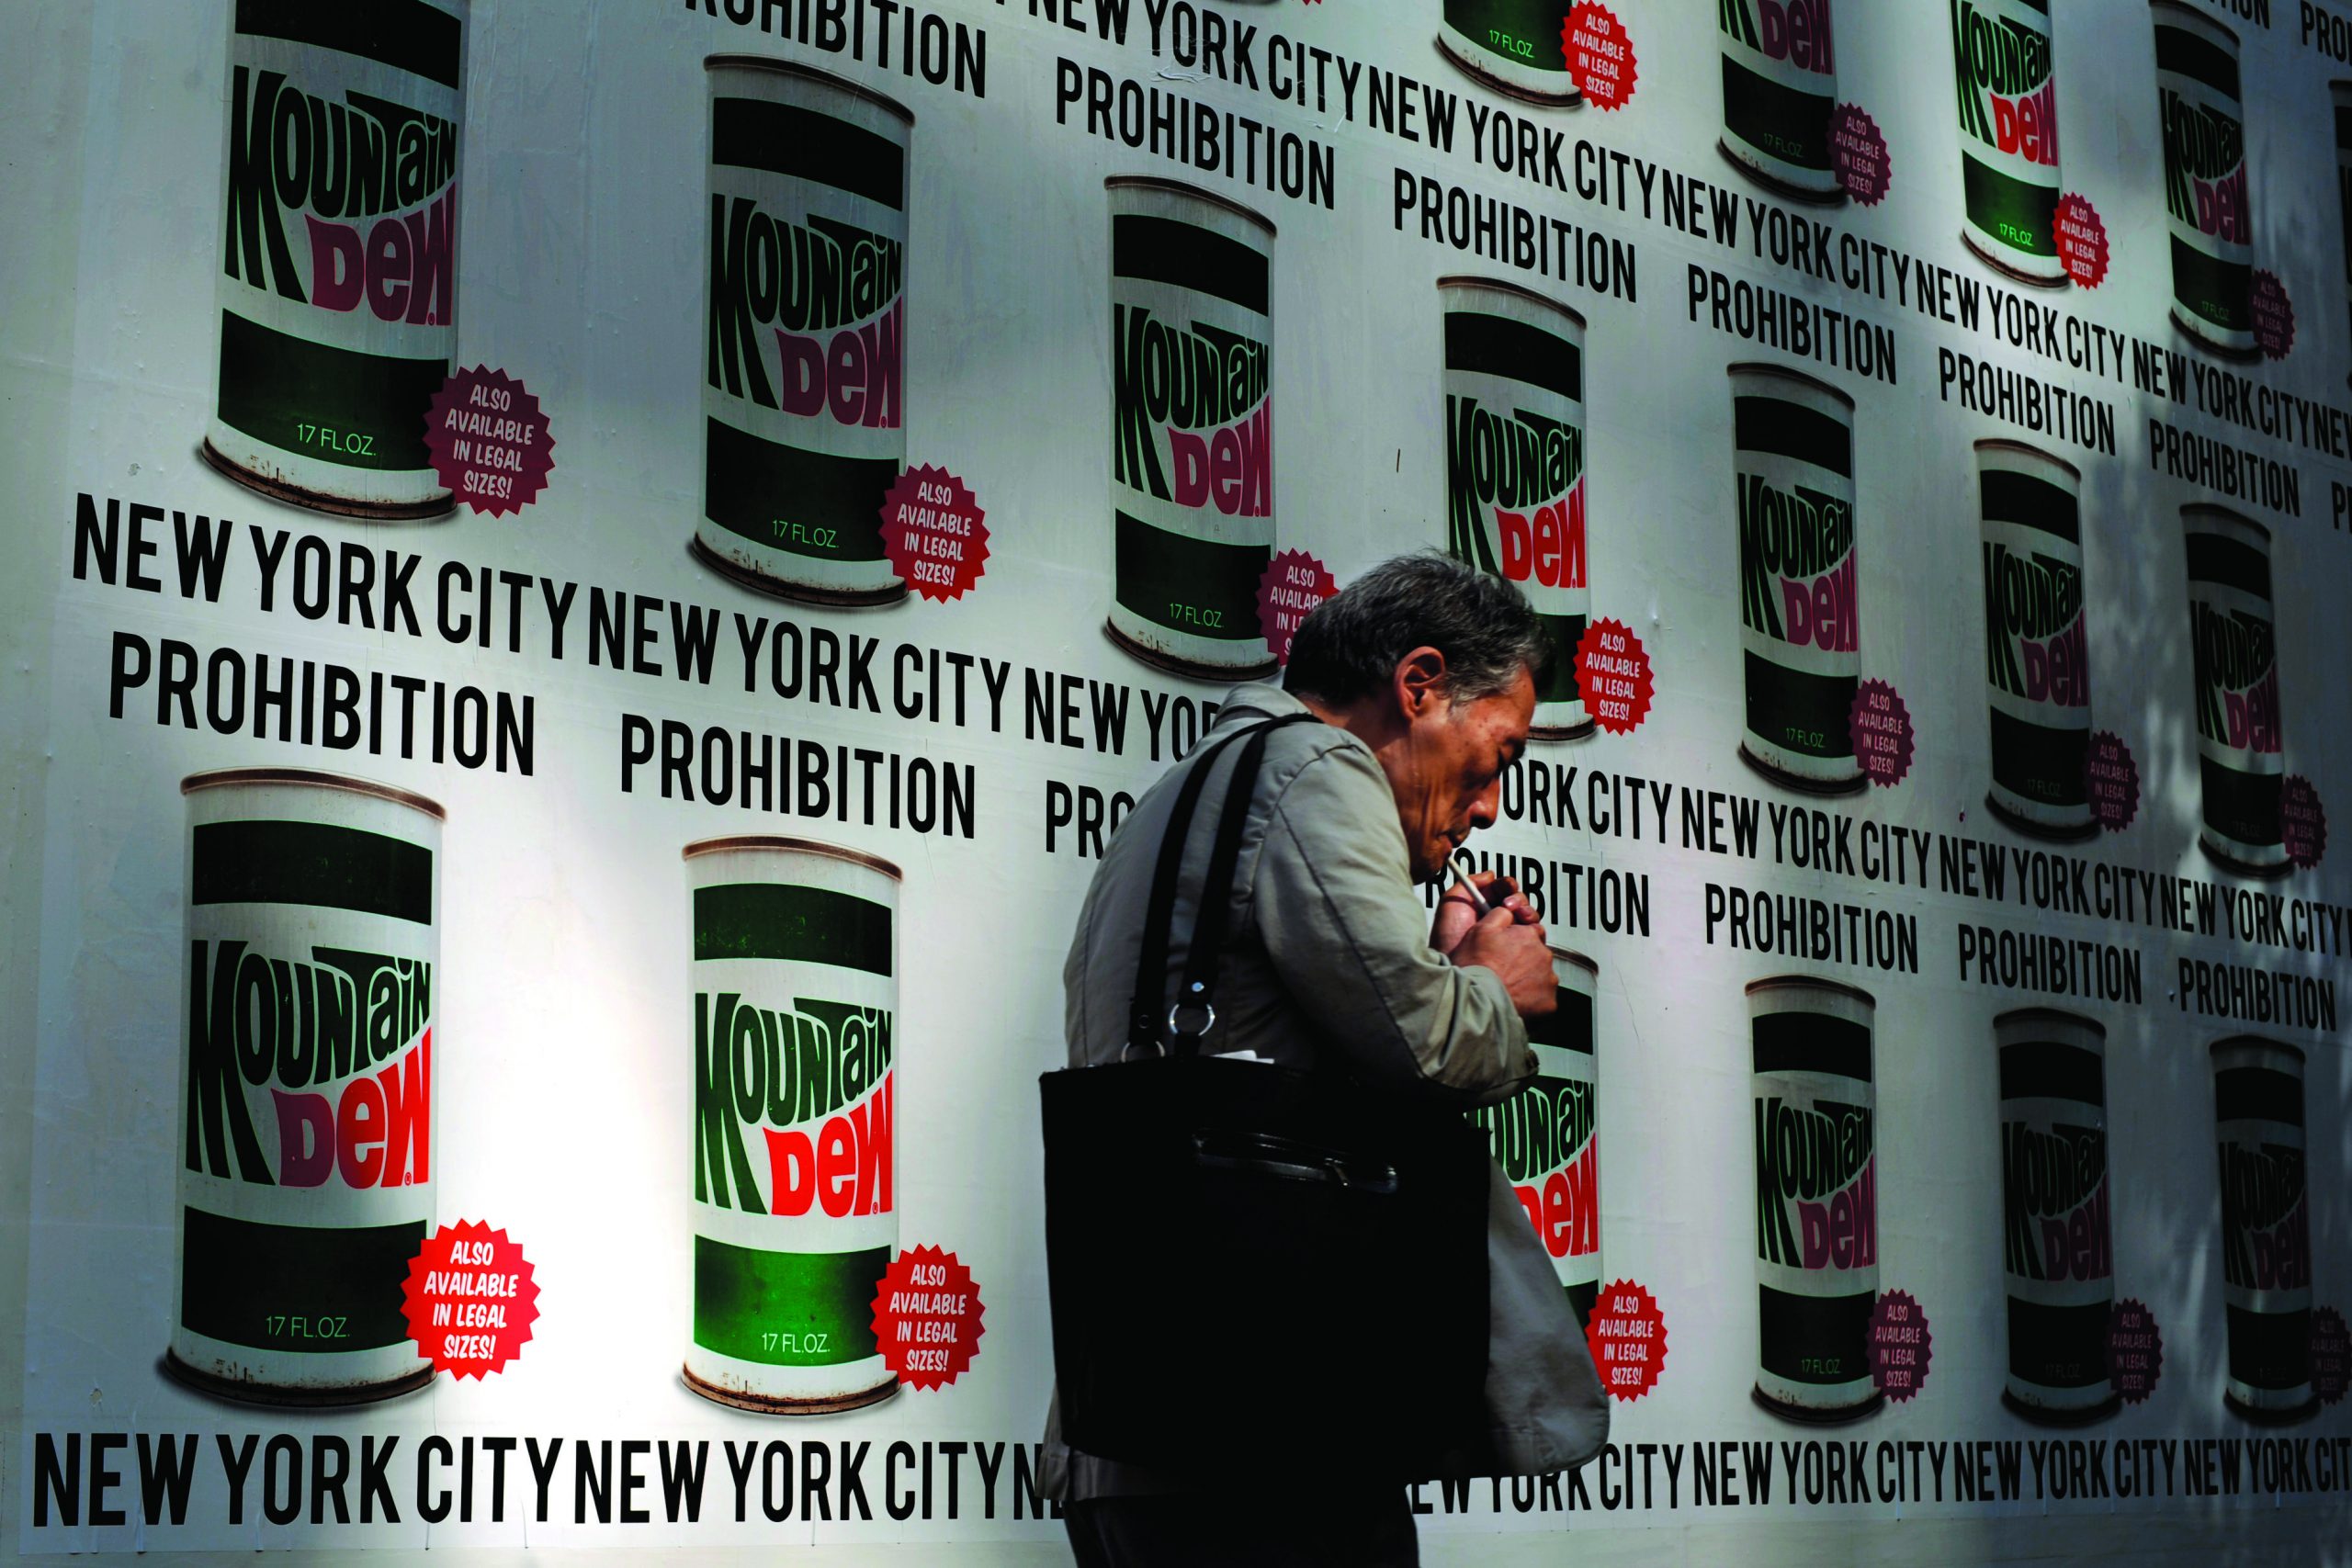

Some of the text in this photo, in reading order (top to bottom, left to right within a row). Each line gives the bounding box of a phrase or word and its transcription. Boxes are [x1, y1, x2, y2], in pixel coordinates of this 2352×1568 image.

[1586, 14, 1611, 34] ALSO
[1488, 30, 1500, 46] 17
[1572, 30, 1624, 61] AVAILABLE
[1146, 0, 1259, 92] YORK
[1267, 33, 1362, 122] CITY
[1577, 52, 1620, 80] IN LEGAL
[1585, 75, 1614, 99] SIZES!
[1057, 56, 1332, 209] PROHIBITION
[1369, 65, 1657, 220] NEW YORK CITY
[2070, 204, 2086, 222] ALSO
[1393, 172, 1635, 299] PROHIBITION
[1662, 168, 1908, 306] NEW YORK CITY
[2061, 219, 2098, 244] AVAILABLE
[2065, 238, 2095, 261] IN LEGAL
[1690, 262, 1893, 389] PROHIBITION
[1917, 259, 2124, 382] NEW YORK CITY
[470, 384, 510, 411] ALSO
[1937, 347, 2116, 455] PROHIBITION
[2132, 338, 2308, 446] NEW YORK CITY
[298, 423, 313, 442] 17
[445, 408, 534, 444] AVAILABLE
[453, 438, 521, 471] IN LEGAL
[2147, 418, 2300, 518] PROHIBITION
[463, 470, 511, 499] SIZES!
[917, 481, 950, 505] ALSO
[774, 519, 786, 536] 17
[898, 503, 971, 536] AVAILABLE
[904, 531, 962, 560] IN LEGAL
[74, 492, 575, 659] NEW YORK CITY
[913, 559, 954, 585] SIZES!
[1286, 565, 1313, 587] ALSO
[1170, 603, 1181, 617] 17
[1277, 612, 1287, 629] IN
[1600, 632, 1624, 651] ALSO
[588, 586, 1010, 731] NEW YORK CITY
[1587, 652, 1639, 677] AVAILABLE
[1592, 675, 1634, 698] IN LEGAL
[106, 635, 537, 773] PROHIBITION
[1025, 668, 1128, 754] NEW
[1600, 699, 1628, 720] SIZES!
[1870, 693, 1889, 710] ALSO
[1859, 711, 1902, 734] AVAILABLE
[1863, 732, 1897, 753] IN LEGAL
[622, 714, 974, 839] PROHIBITION
[1502, 759, 1670, 843] ORK CITY
[1682, 786, 1929, 887] NEW YORK CITY
[1939, 835, 2154, 924] NEW YORK CITY
[2160, 874, 2214, 934] NEW
[2222, 886, 2287, 946] YORK
[2291, 898, 2341, 954] CITY
[1707, 883, 1916, 973] PROHIBITION
[1954, 924, 2143, 1003] PROHIBITION
[2178, 957, 2336, 1032] PROHIBITION
[450, 1241, 492, 1264] ALSO
[424, 1272, 518, 1295] AVAILABLE
[910, 1264, 945, 1286] ALSO
[432, 1303, 504, 1327] IN LEGAL
[889, 1292, 967, 1314] AVAILABLE
[1613, 1295, 1637, 1313] ALSO
[1887, 1304, 1907, 1321] ALSO
[266, 1315, 283, 1334] 17
[897, 1321, 956, 1343] IN LEGAL
[1599, 1319, 1653, 1337] AVAILABLE
[1875, 1326, 1920, 1343] AVAILABLE
[443, 1335, 494, 1359] SIZES!
[763, 1333, 777, 1350] 17
[1604, 1343, 1646, 1360] IN LEGAL
[906, 1349, 948, 1371] SIZES!
[1880, 1348, 1915, 1364] IN LEGAL
[1611, 1367, 1641, 1384] SIZES!
[33, 1433, 562, 1524] NEW YORK CITY
[1600, 1444, 1684, 1509] CITY
[1695, 1441, 1946, 1505] NEW YORK CITY
[1953, 1440, 2177, 1499] NEW YORK CITY
[2184, 1439, 2239, 1494] NEW
[2245, 1438, 2311, 1492] YORK
[575, 1440, 708, 1523] NEW
[724, 1440, 872, 1522] YORK
[886, 1441, 1005, 1520] CITY
